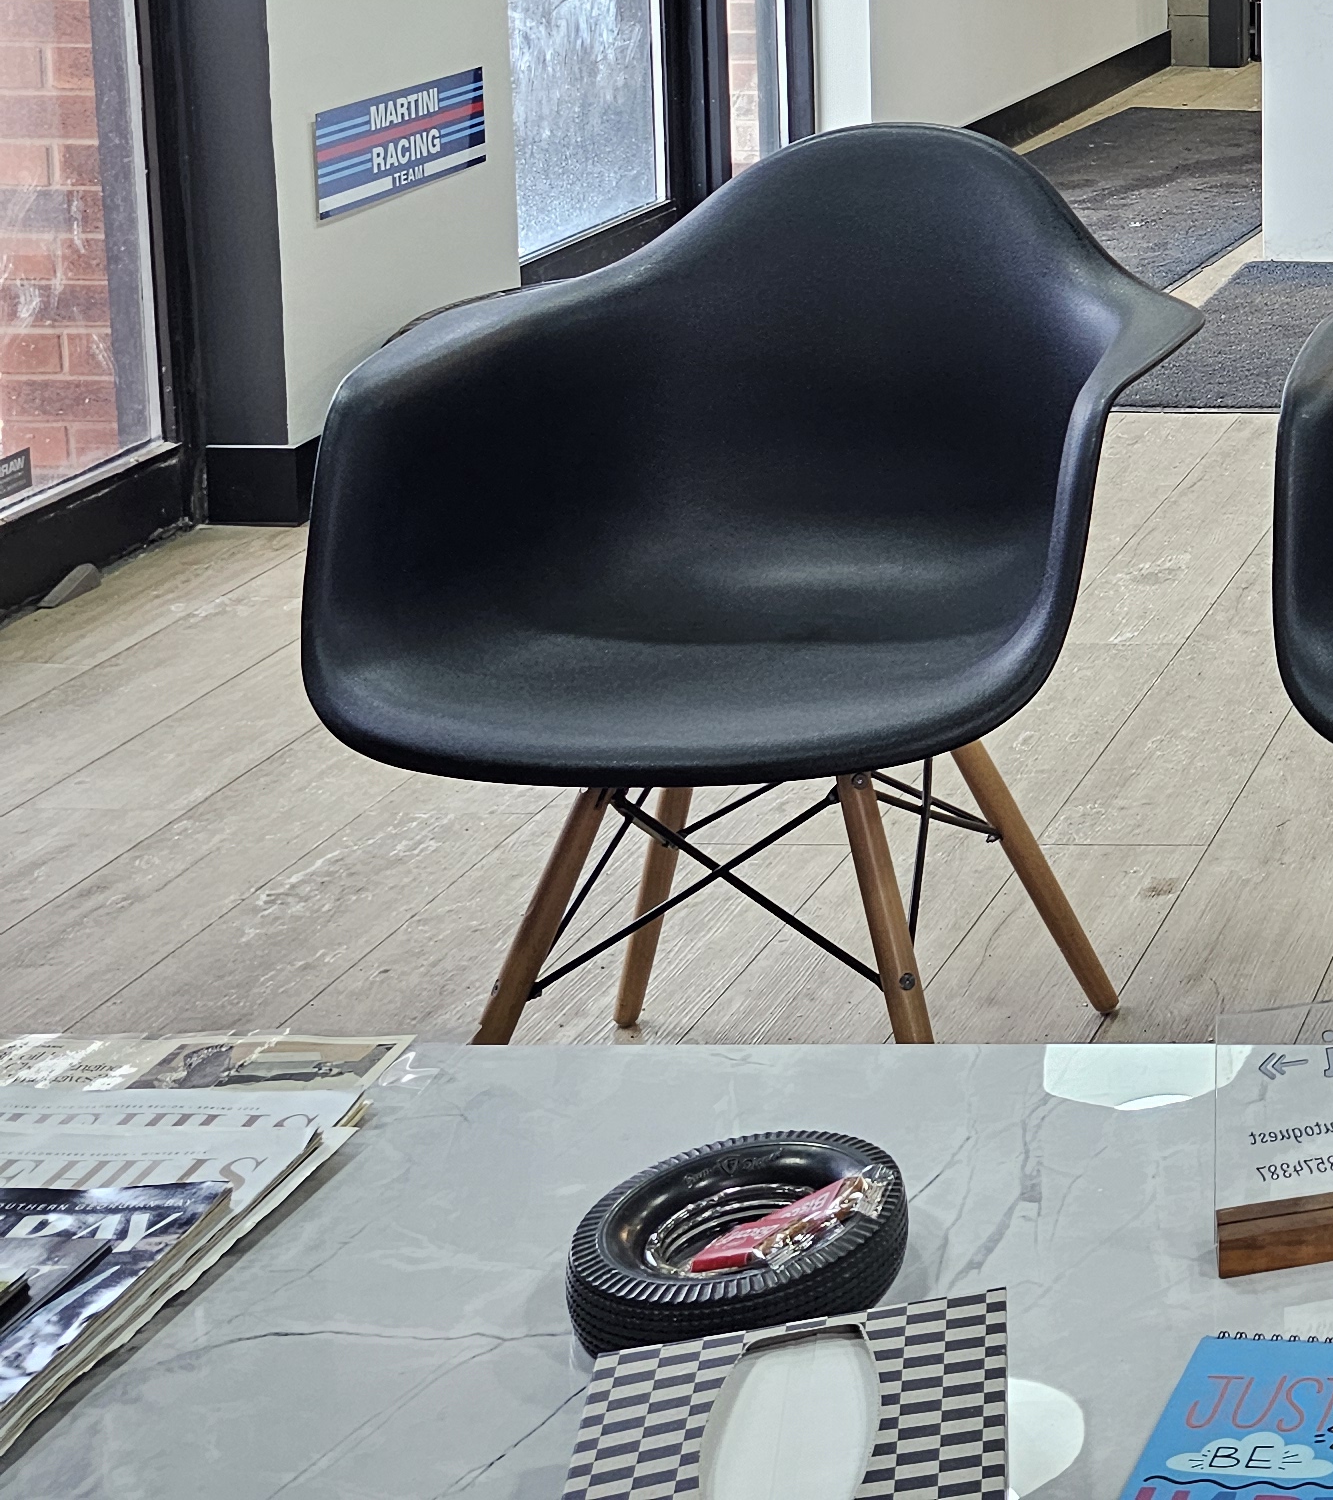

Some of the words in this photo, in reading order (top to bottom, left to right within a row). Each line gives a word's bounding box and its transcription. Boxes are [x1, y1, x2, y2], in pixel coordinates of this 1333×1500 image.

[369, 87, 440, 131] MARTINI
[372, 128, 441, 174] RACING
[393, 164, 424, 187] TEAM
[1208, 1445, 1275, 1470] BE
